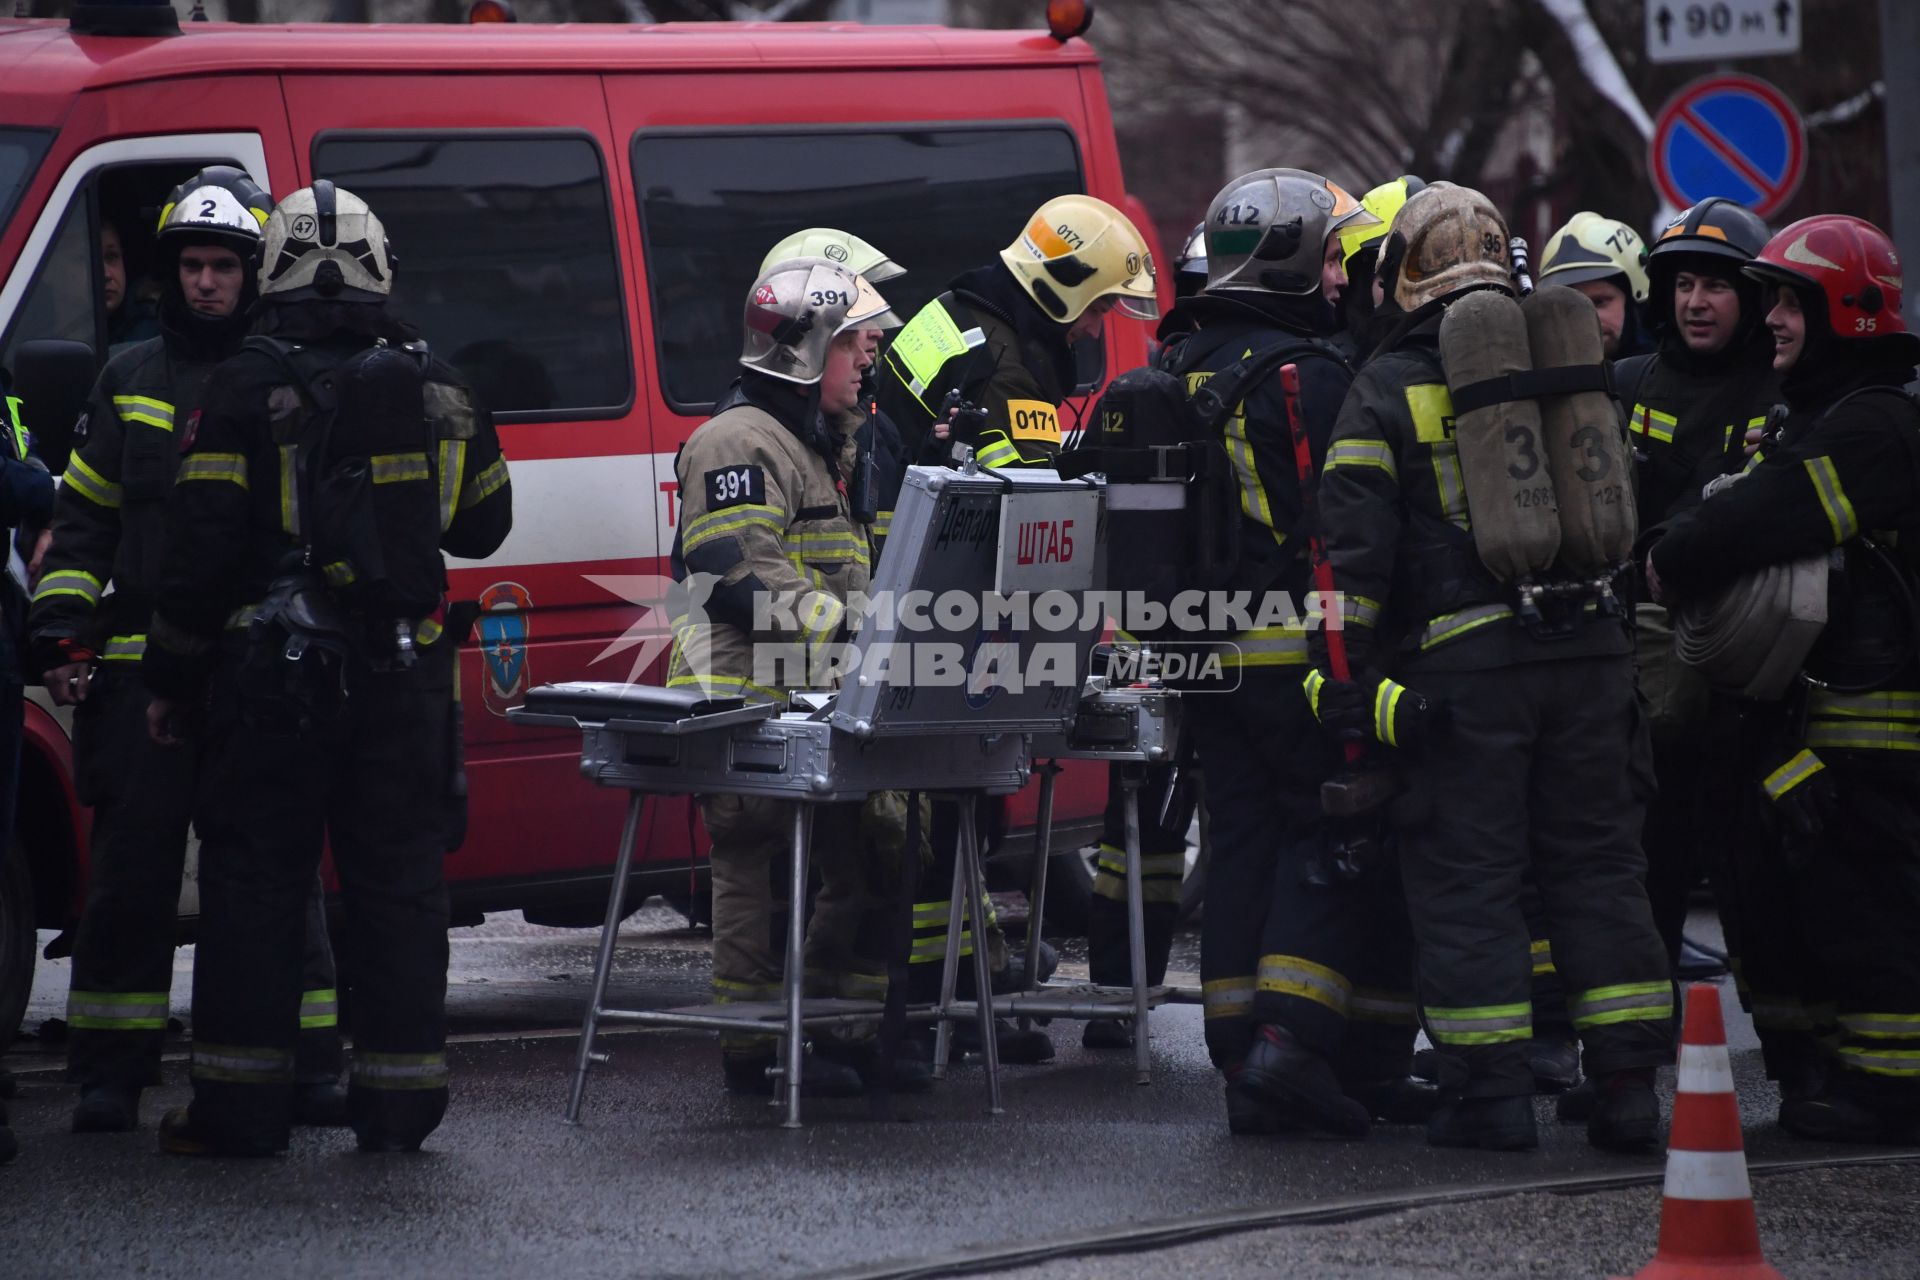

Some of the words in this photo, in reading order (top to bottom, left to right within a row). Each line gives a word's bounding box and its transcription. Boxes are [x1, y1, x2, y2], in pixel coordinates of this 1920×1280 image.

[1686, 3, 1731, 38] 90
[200, 200, 216, 218] 2
[1217, 205, 1260, 225] 412
[295, 221, 314, 234] 47
[1057, 224, 1084, 251] 0171
[1484, 232, 1501, 253] 35
[1127, 255, 1139, 272] 17
[756, 286, 775, 303] СПТ
[810, 290, 848, 307] 391
[1855, 317, 1877, 332] 35
[1015, 408, 1057, 433] 0171
[1102, 411, 1125, 432] 12
[1504, 425, 1539, 480] 3
[1570, 426, 1611, 482] 3
[715, 468, 751, 501] 391
[1017, 519, 1074, 565] ШТАБ
[889, 686, 917, 711] 791
